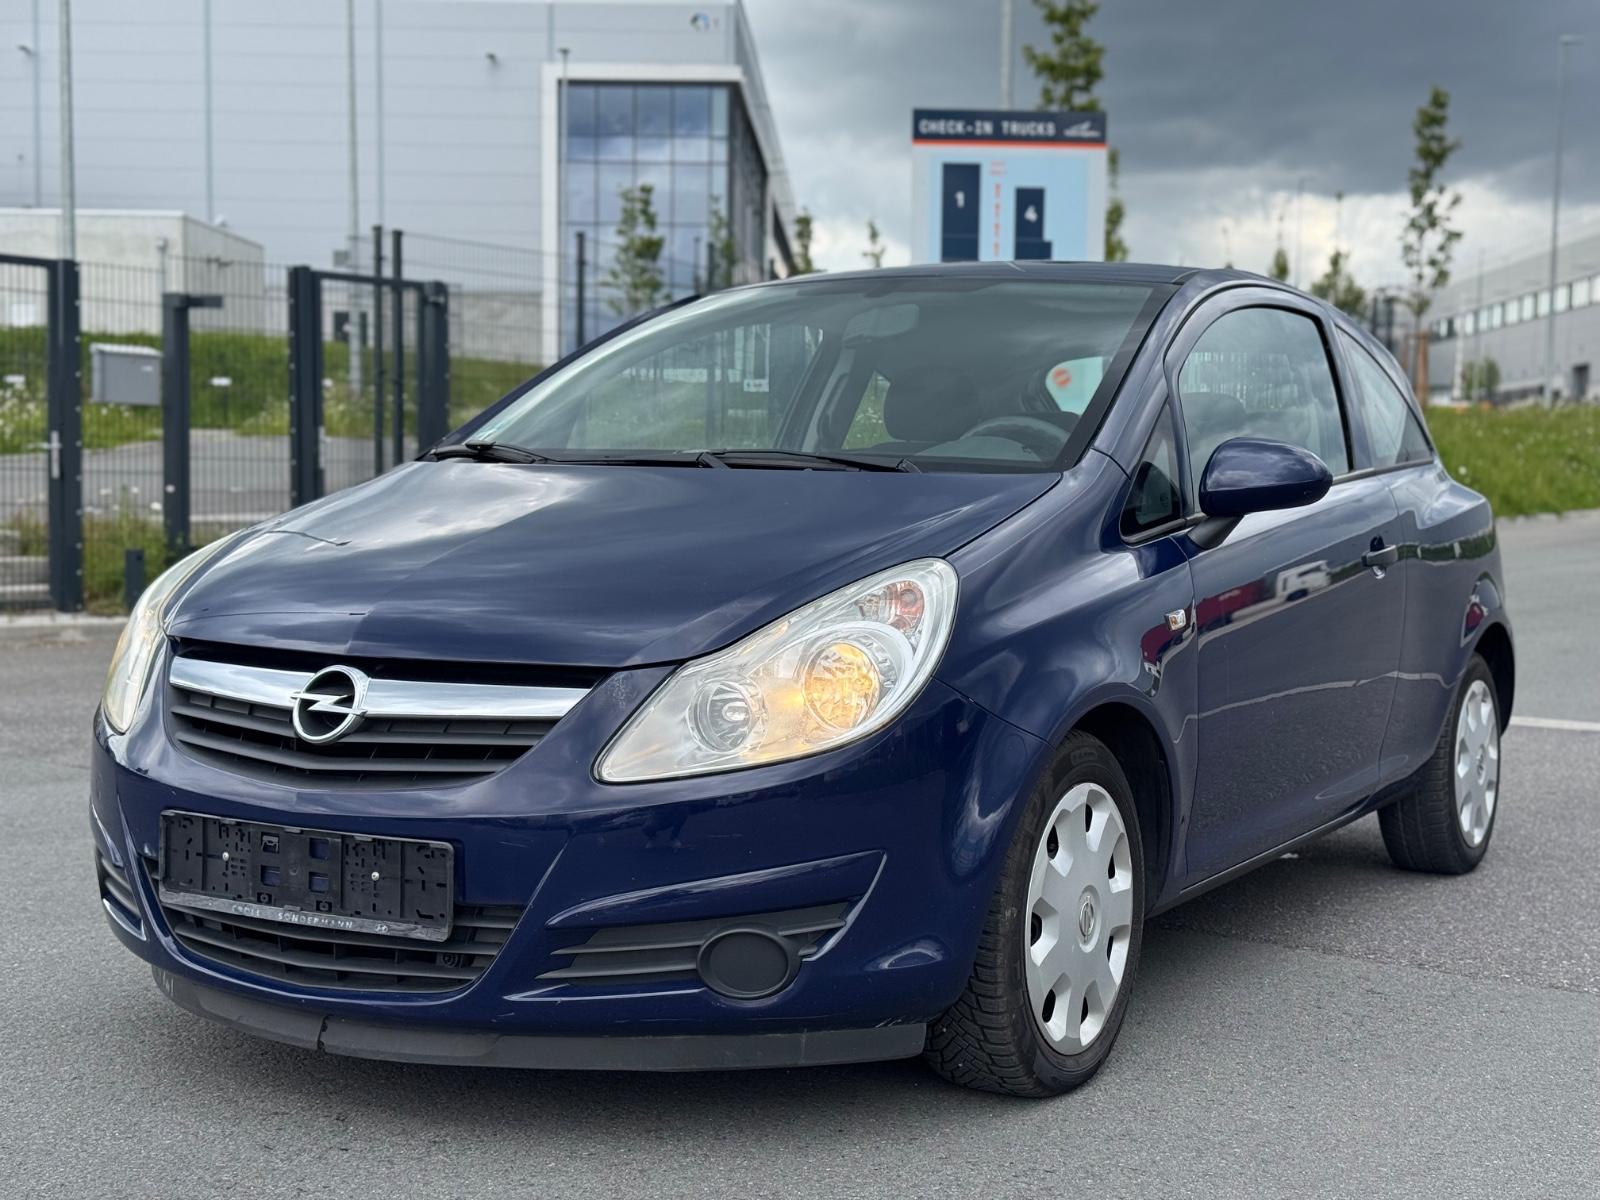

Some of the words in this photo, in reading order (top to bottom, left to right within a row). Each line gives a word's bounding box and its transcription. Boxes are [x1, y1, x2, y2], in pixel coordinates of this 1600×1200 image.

[918, 118, 994, 136] CHECK-IN
[1001, 120, 1057, 137] TRUCKS
[955, 191, 965, 208] 1
[1024, 206, 1038, 223] 4
